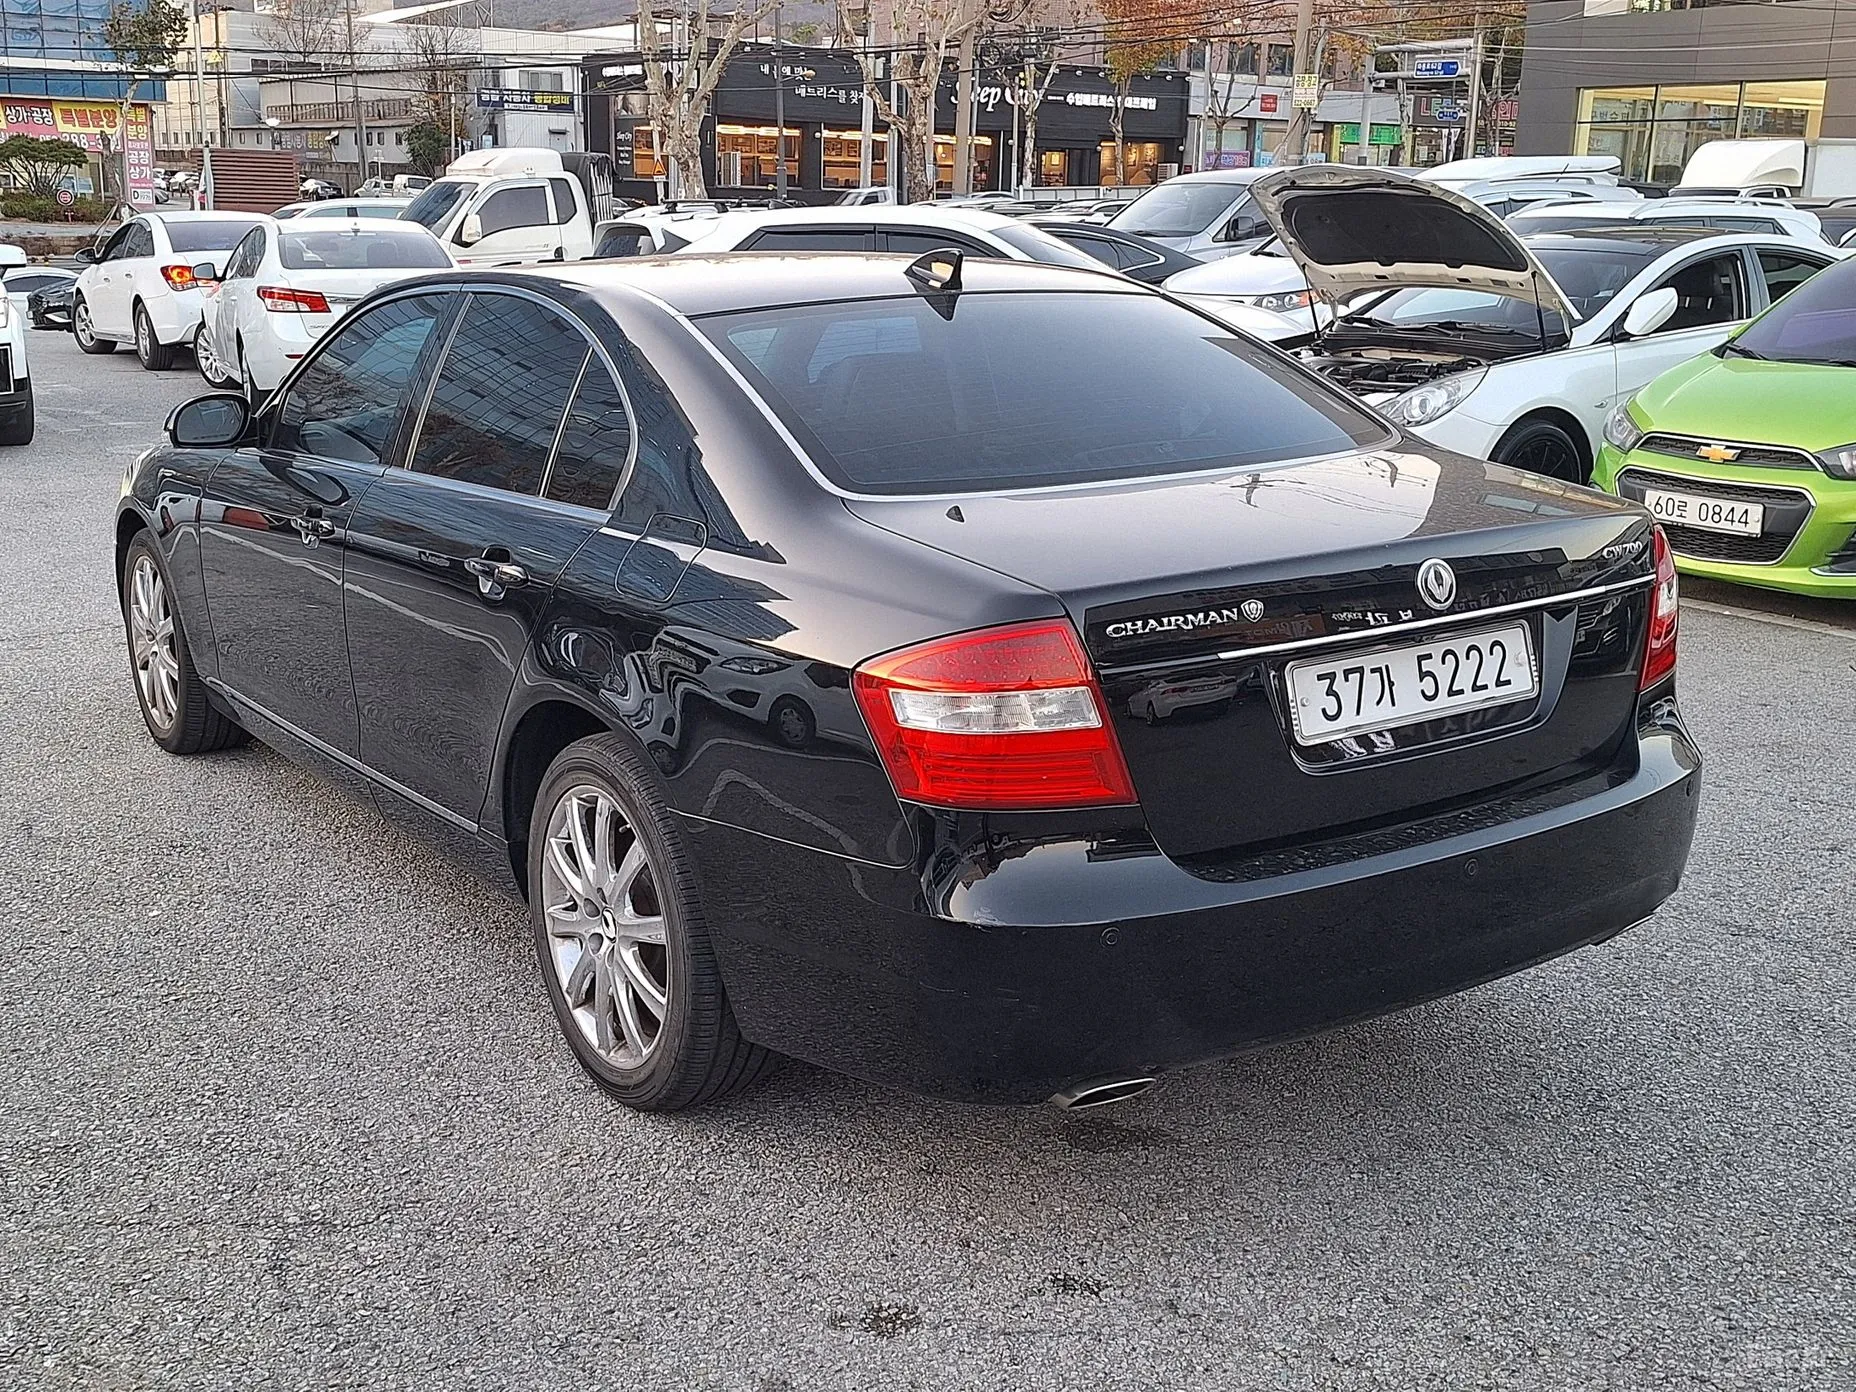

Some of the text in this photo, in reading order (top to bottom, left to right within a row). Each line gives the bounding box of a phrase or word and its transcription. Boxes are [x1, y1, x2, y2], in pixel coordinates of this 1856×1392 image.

[760, 63, 770, 75] 내
[59, 108, 118, 129] 특별분양
[127, 124, 148, 141] 분양
[128, 150, 150, 165] 공장
[129, 165, 151, 180] 상가
[1653, 495, 1750, 528] 60로 0844
[1105, 607, 1239, 638] CHAIRMAN
[1315, 639, 1513, 723] 37가 5222
